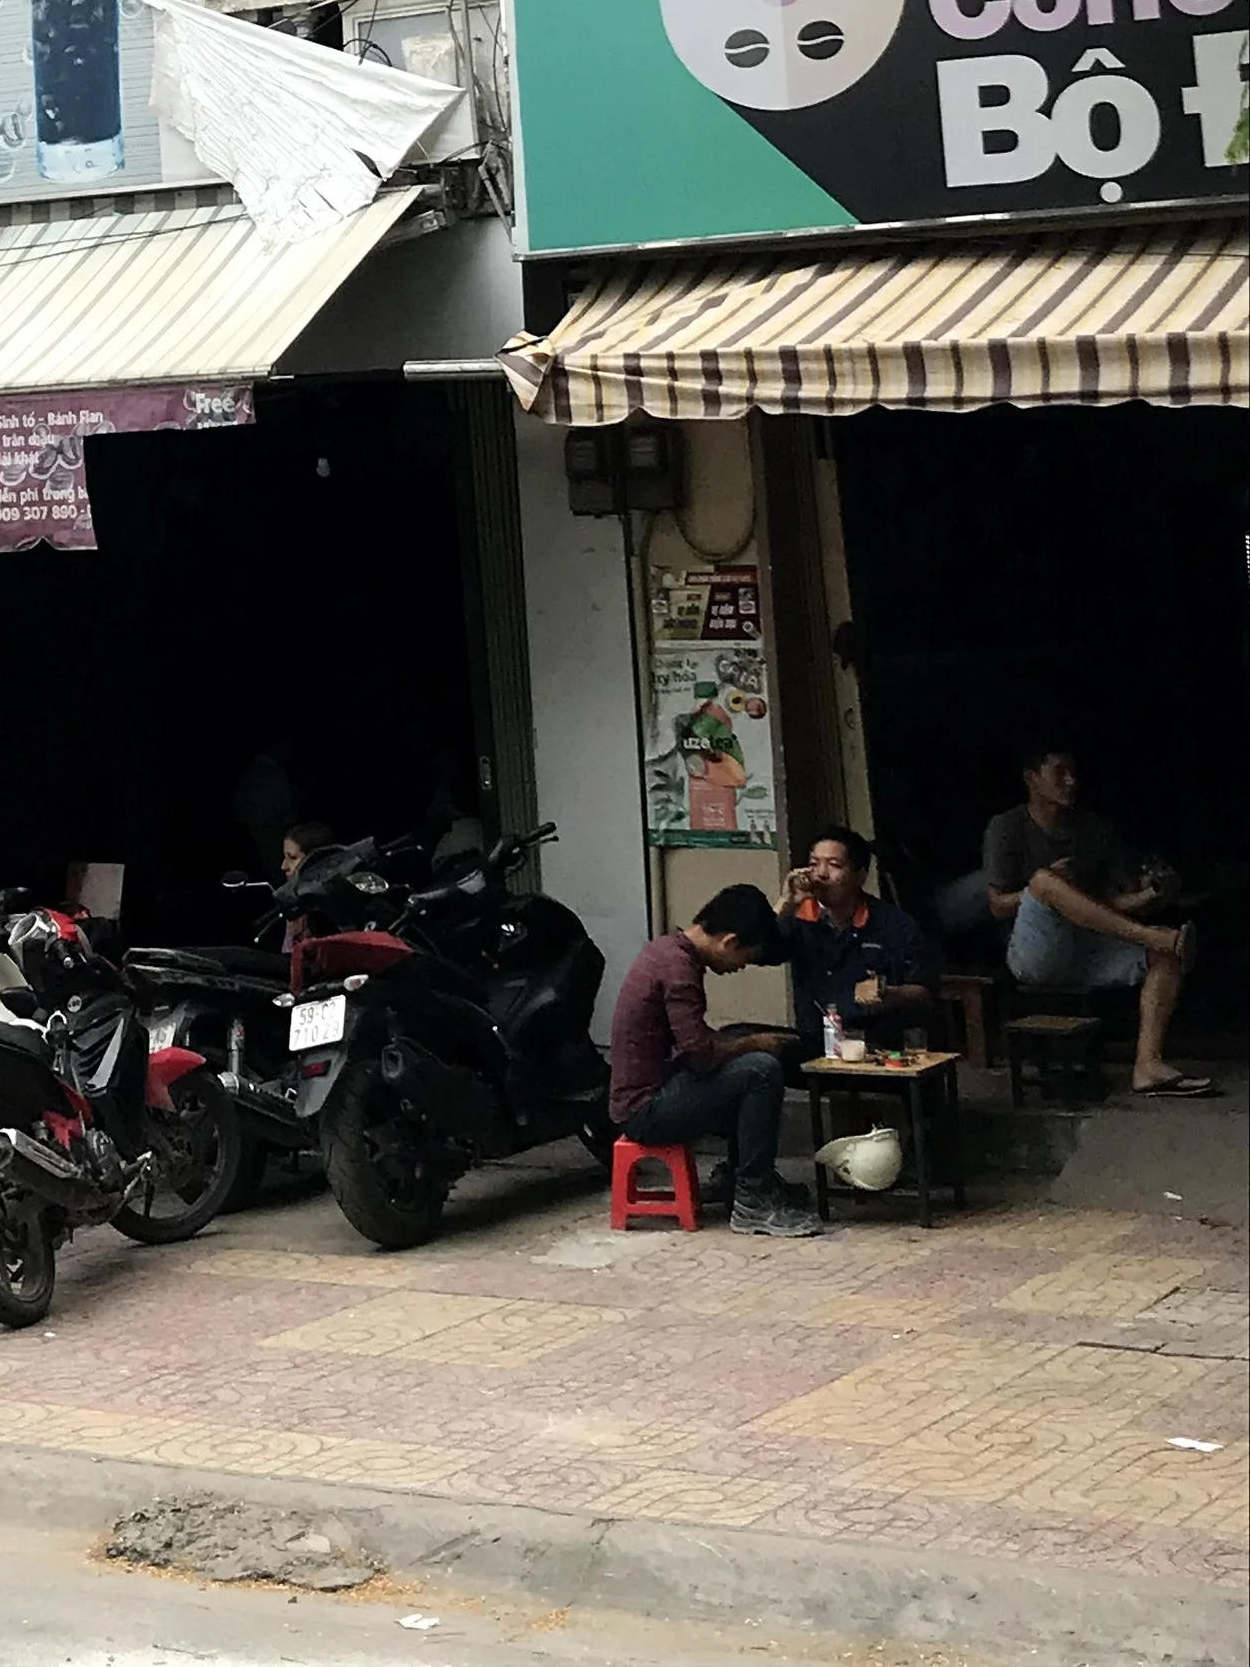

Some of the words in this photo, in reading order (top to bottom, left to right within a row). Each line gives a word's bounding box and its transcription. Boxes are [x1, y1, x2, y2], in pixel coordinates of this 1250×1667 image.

[936, 47, 1161, 203] Bộ
[195, 392, 236, 415] Free
[47, 411, 77, 427] Bánh
[23, 505, 49, 521] 307
[51, 504, 78, 520] 890
